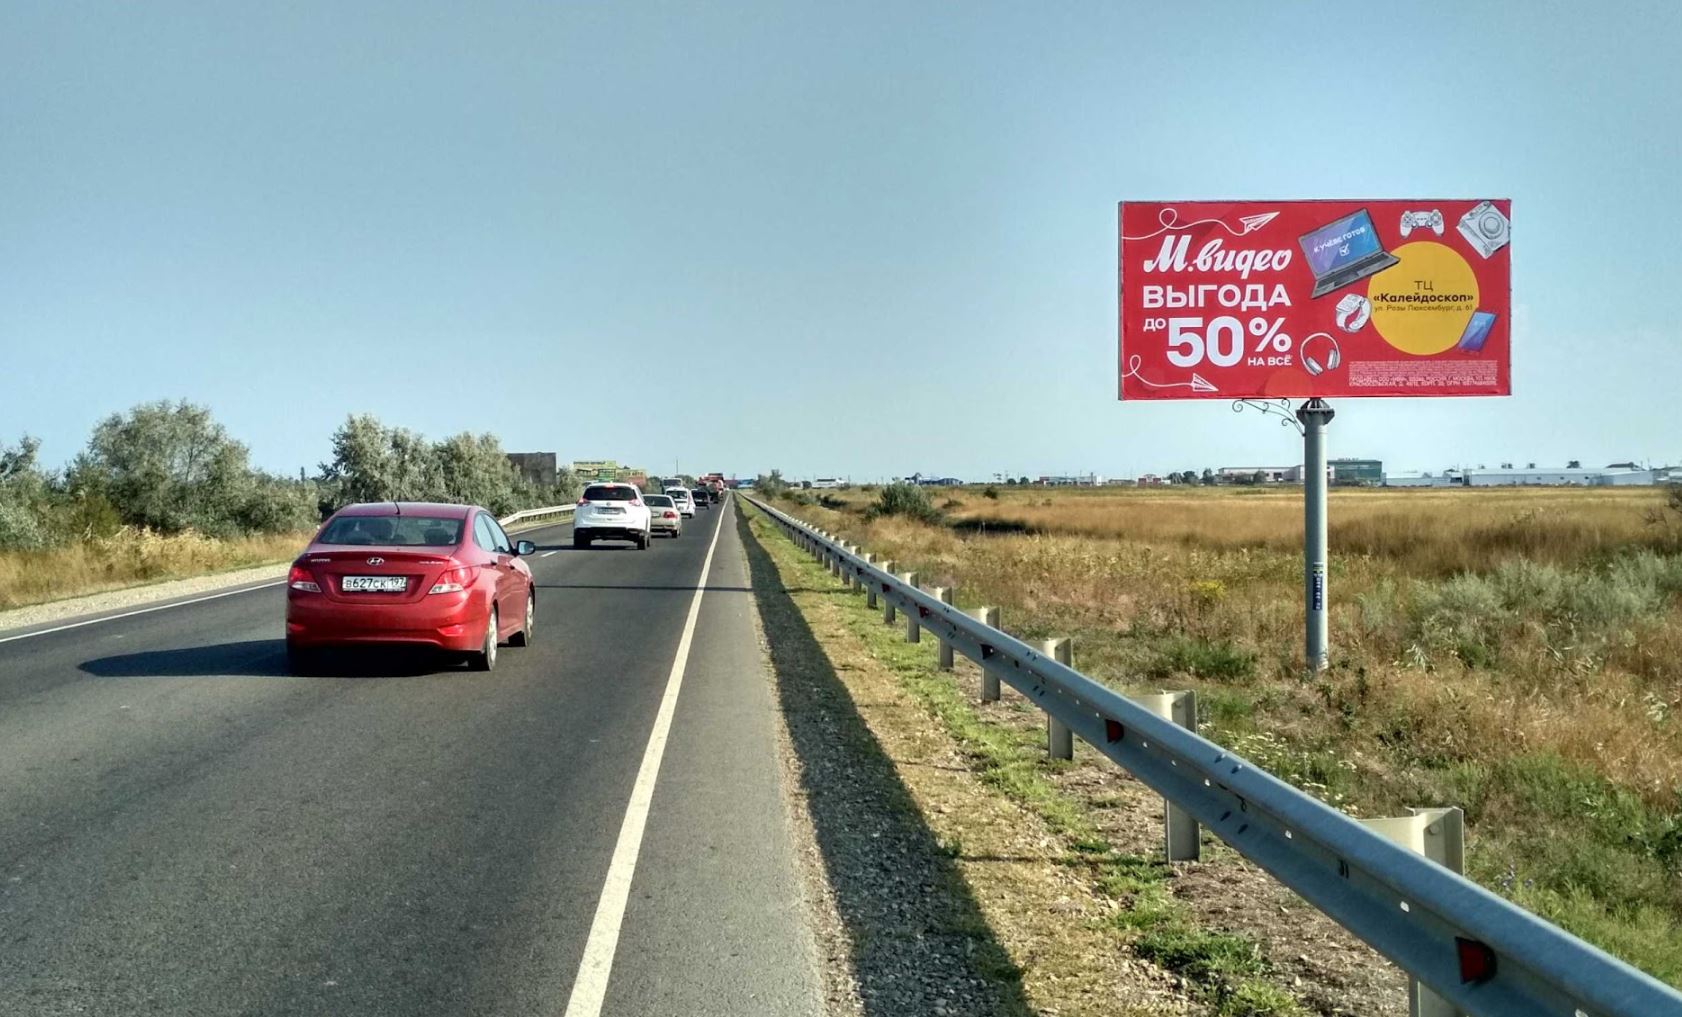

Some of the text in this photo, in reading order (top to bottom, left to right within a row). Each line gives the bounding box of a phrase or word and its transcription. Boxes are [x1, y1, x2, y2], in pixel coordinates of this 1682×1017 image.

[1143, 235, 1292, 279] М.видео
[1414, 280, 1433, 291] ТЦ
[1143, 284, 1292, 312] ВЫГОДА
[1373, 292, 1473, 304] «Калейдоскоп»
[1166, 316, 1292, 367] 50%
[1247, 356, 1265, 366] НА
